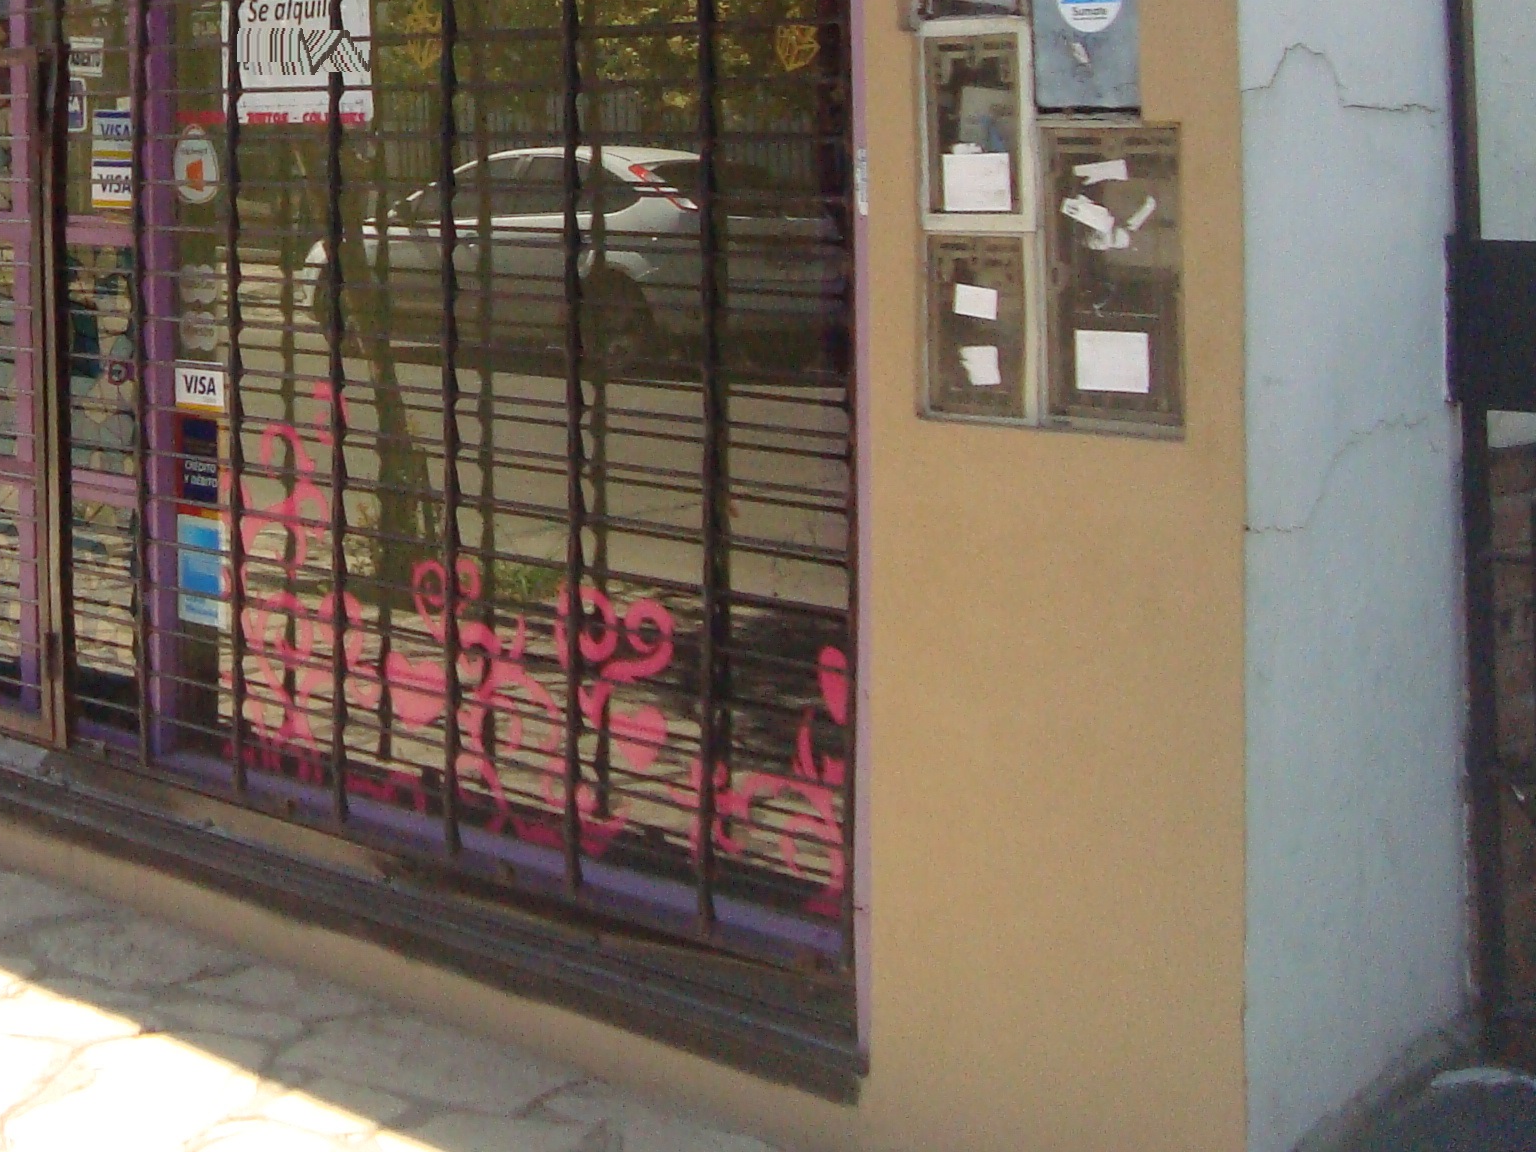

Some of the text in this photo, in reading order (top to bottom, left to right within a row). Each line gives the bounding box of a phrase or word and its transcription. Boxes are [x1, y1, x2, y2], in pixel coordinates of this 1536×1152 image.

[247, 0, 269, 22] Se
[100, 123, 132, 141] VISA
[99, 174, 132, 194] VISA
[183, 374, 216, 396] VISA
